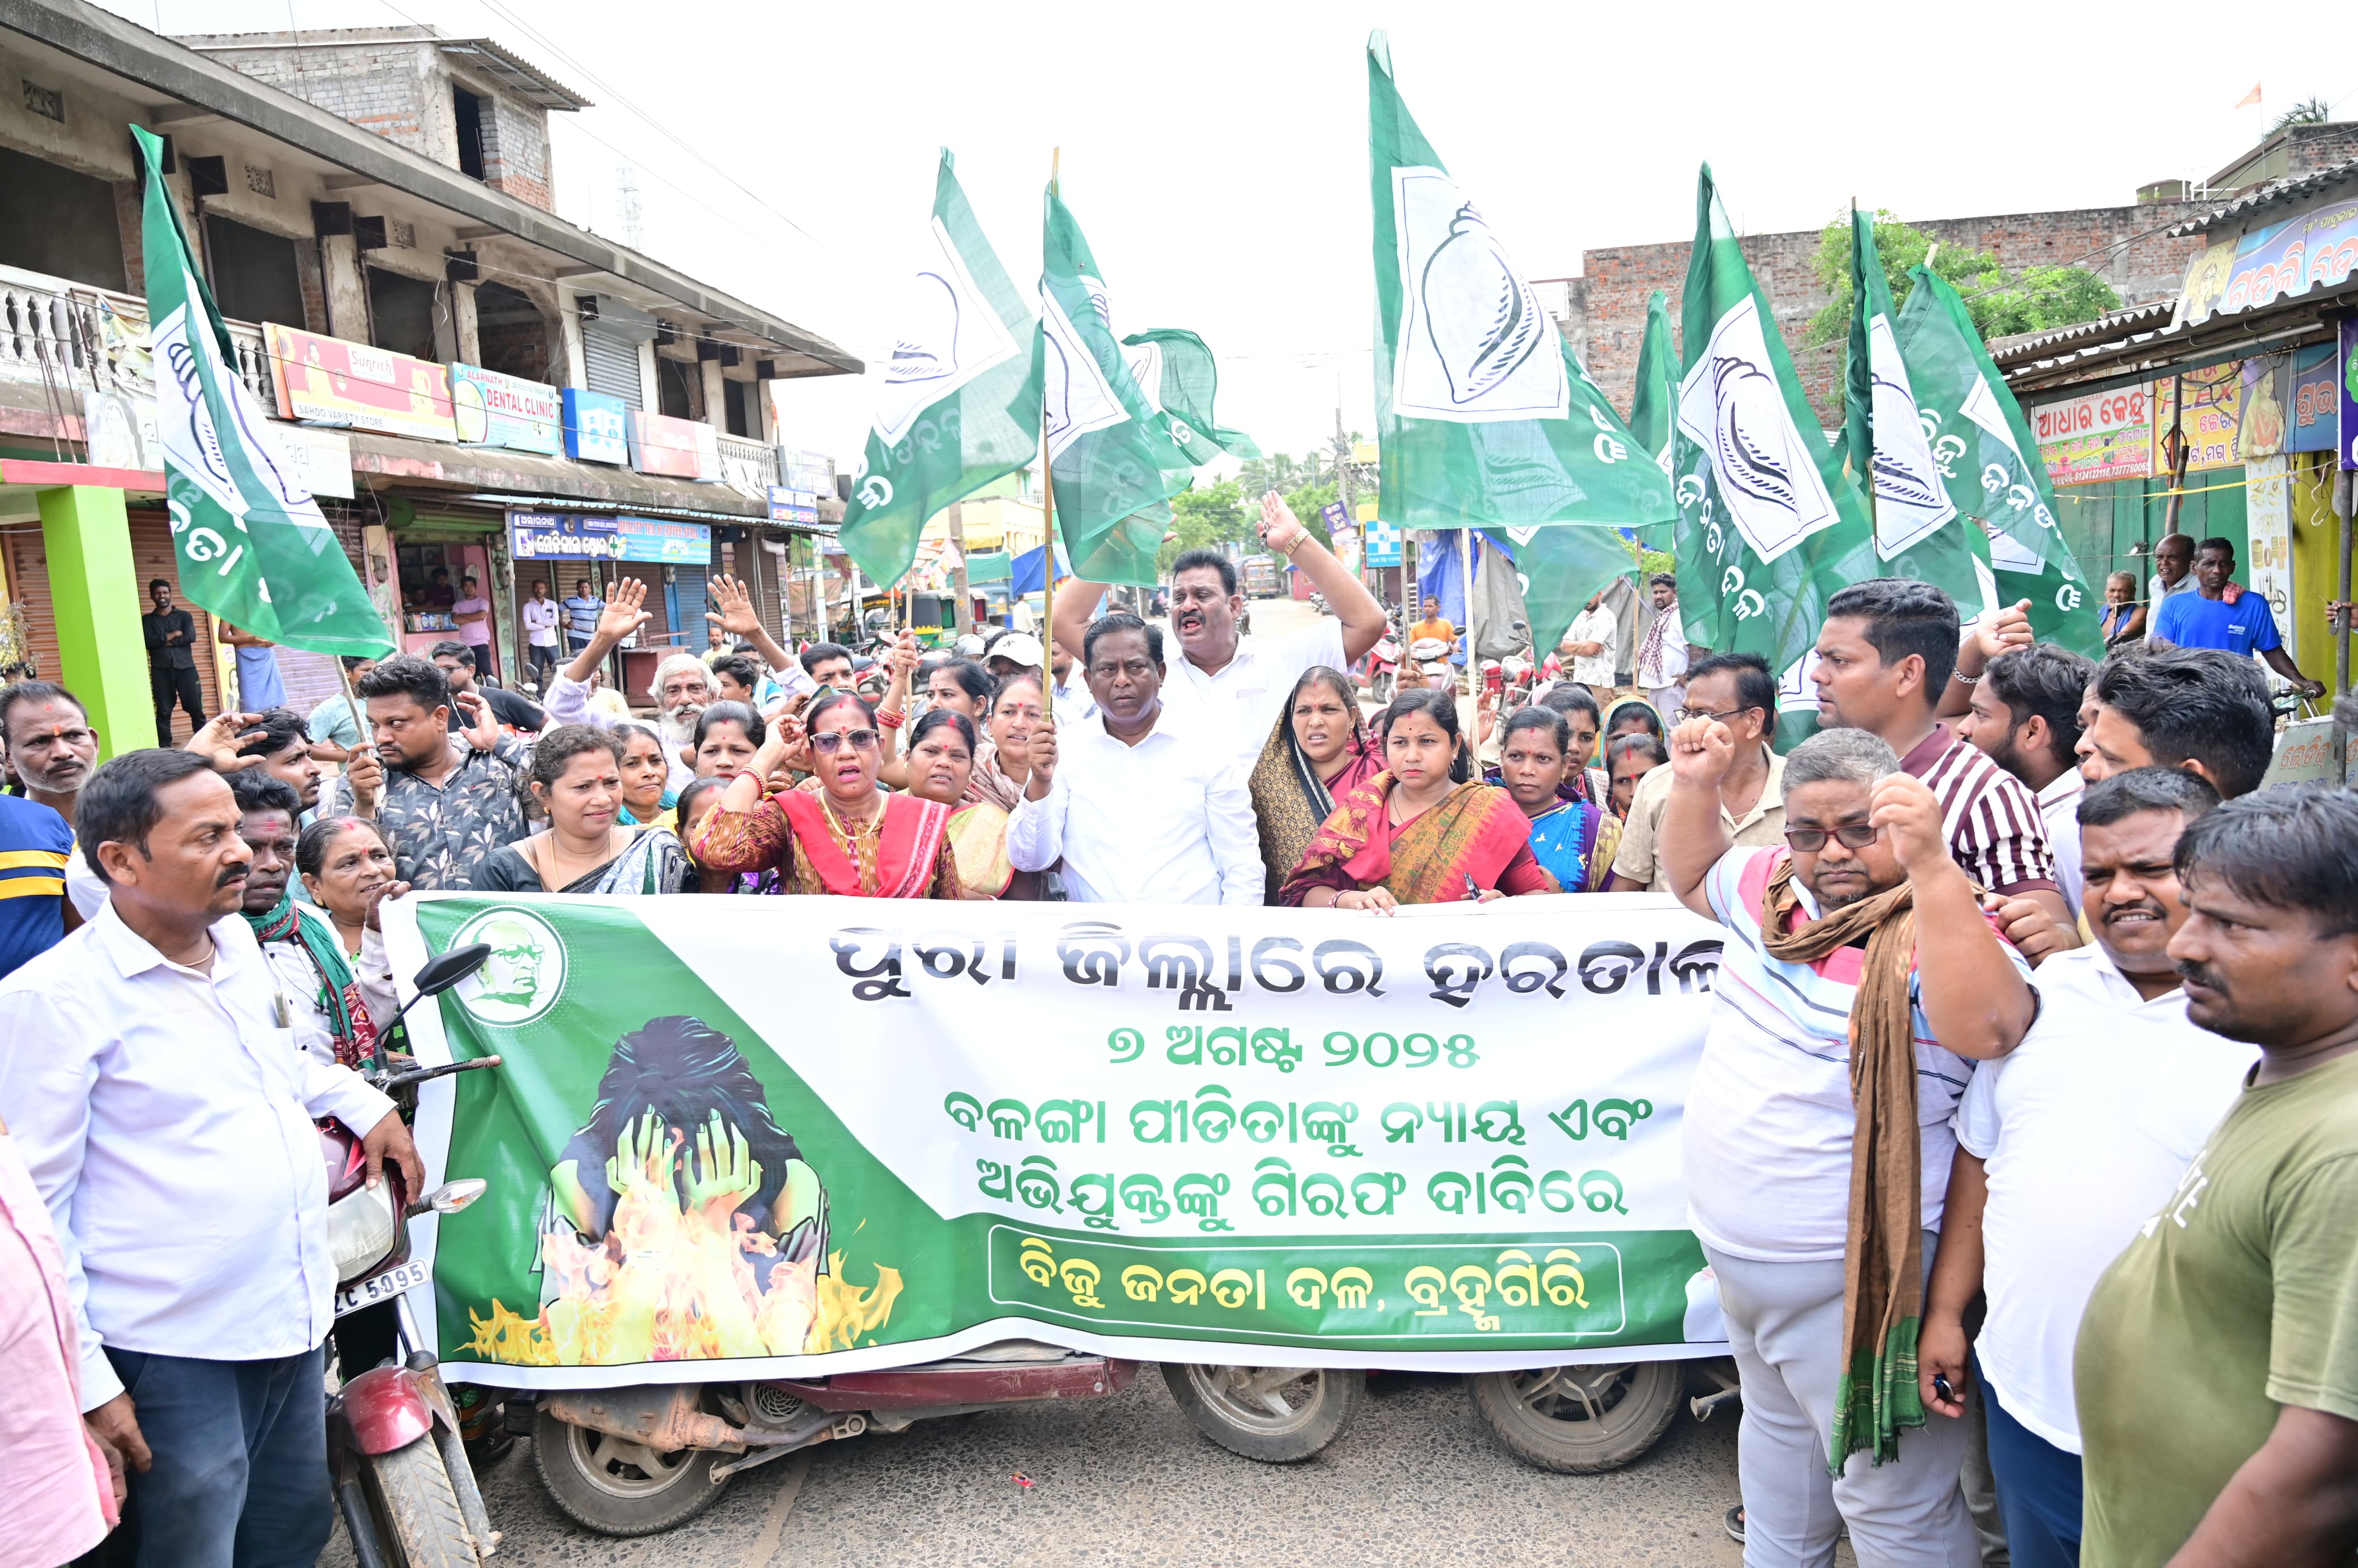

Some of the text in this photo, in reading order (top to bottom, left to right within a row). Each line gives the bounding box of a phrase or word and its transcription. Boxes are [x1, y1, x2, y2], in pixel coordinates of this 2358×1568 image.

[351, 350, 393, 377] Sunrich
[468, 370, 502, 386] ALARNATH
[487, 388, 523, 412] DENTAL
[525, 397, 554, 419] CLINIC
[2073, 393, 2103, 405] AADHAAR
[299, 405, 384, 427] SAHOO VARIETY STORE
[2039, 404, 2093, 437] ଆଧାର
[618, 520, 643, 534] QUALITY
[645, 522, 655, 535] TEA
[657, 525, 662, 536] &
[663, 525, 682, 538] COFFEE
[684, 528, 699, 538] STALL
[1057, 921, 1387, 1012] ଜିଲ୍ଲାରେ
[1423, 939, 1724, 1008] ହରତାଳ
[1108, 1025, 1481, 1073] ୭ ଅଗଷ୍ଟ ୨୦୨୫
[944, 1091, 1105, 1144] ବଳଙ୍ଗା
[1380, 1099, 1527, 1146] ନ୍ୟାୟ
[1547, 1098, 1653, 1141] ଏବଂ
[976, 1154, 1630, 1232] ଅଭିଯୁକ୍ତଙ୍କୁ ଗିରଫ ଦାବିରେ
[366, 1264, 423, 1298] 5095
[1020, 1237, 1590, 1331] ବିଜୁ ଜନତା ଦଳ, ବ୍ରହ୍ମଗିରି
